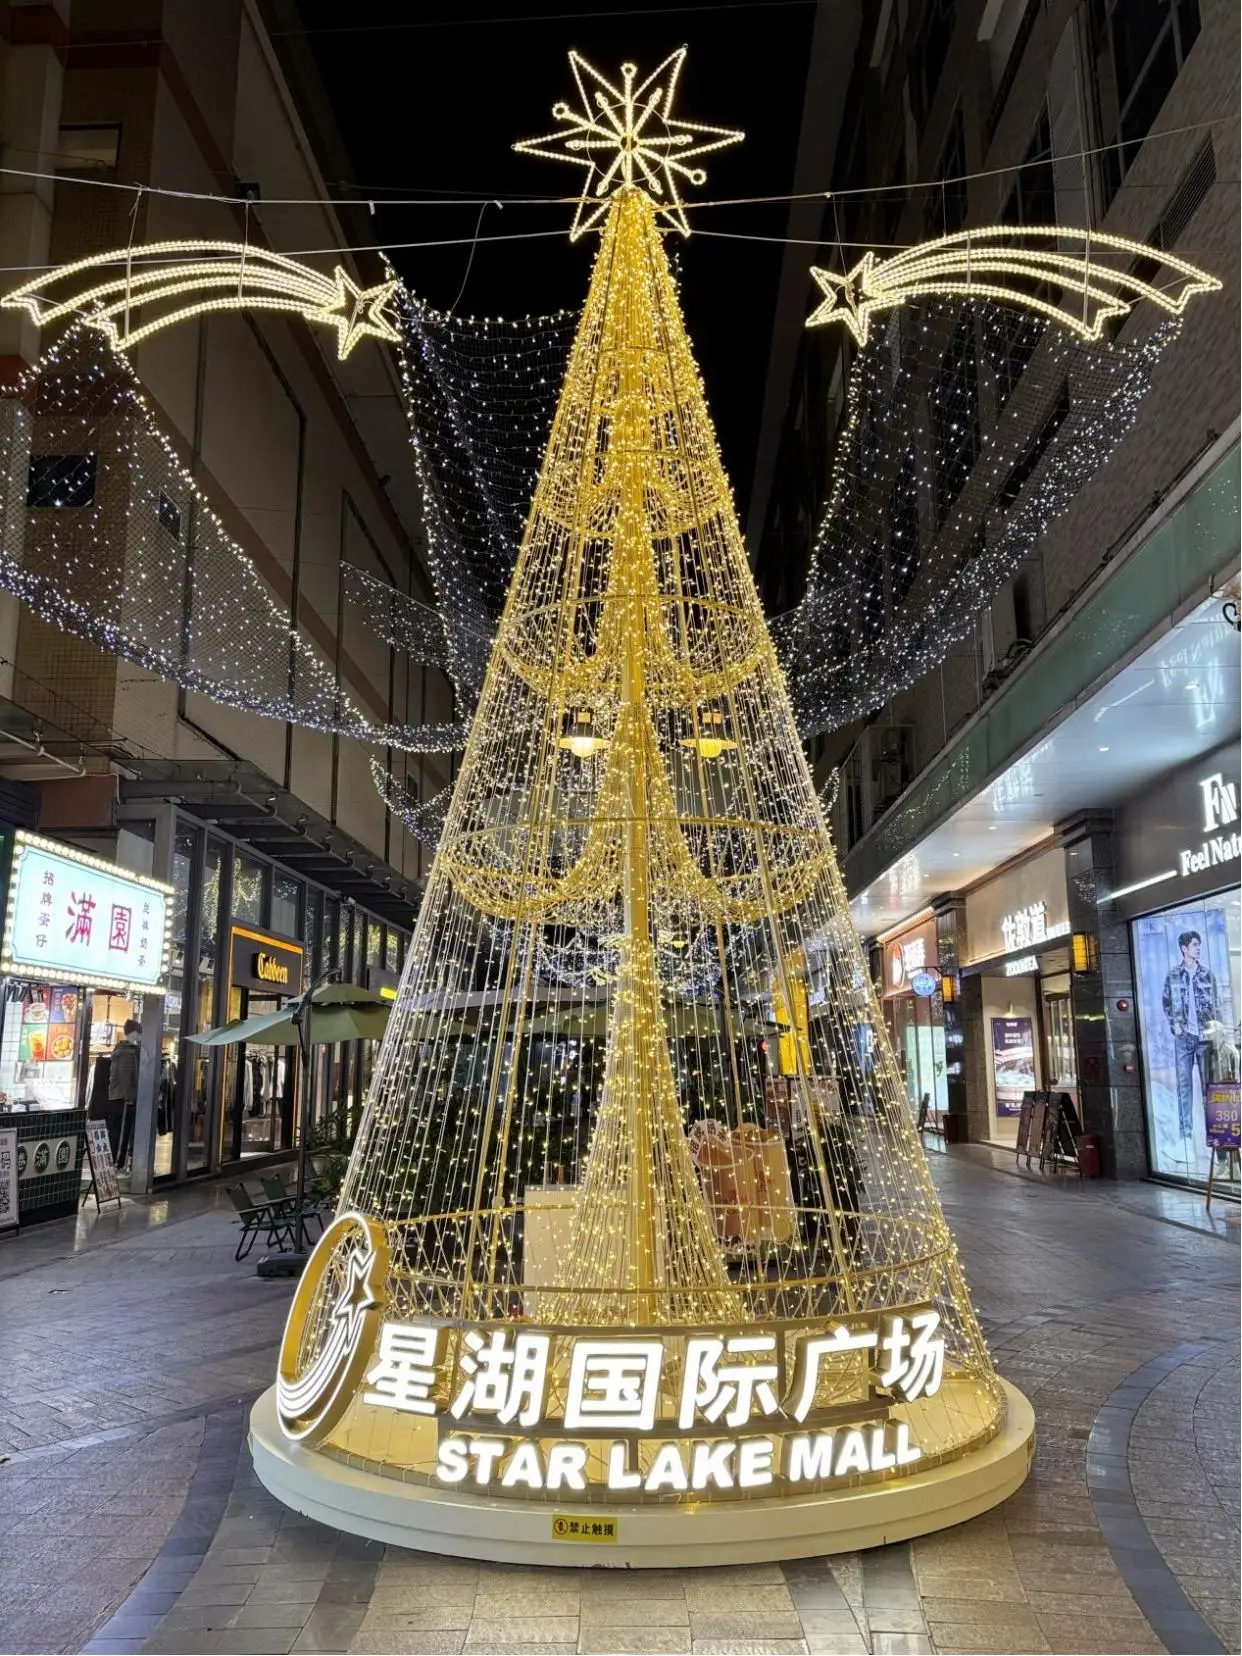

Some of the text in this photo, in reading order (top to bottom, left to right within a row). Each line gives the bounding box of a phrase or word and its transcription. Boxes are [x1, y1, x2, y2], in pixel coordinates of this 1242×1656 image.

[1180, 843, 1211, 877] Feel
[1215, 1110, 1238, 1122] 380
[363, 1311, 945, 1430] 星湖国际广场
[436, 1422, 922, 1491] STAR LAKE MALL
[568, 1520, 614, 1537] 禁止触摸
